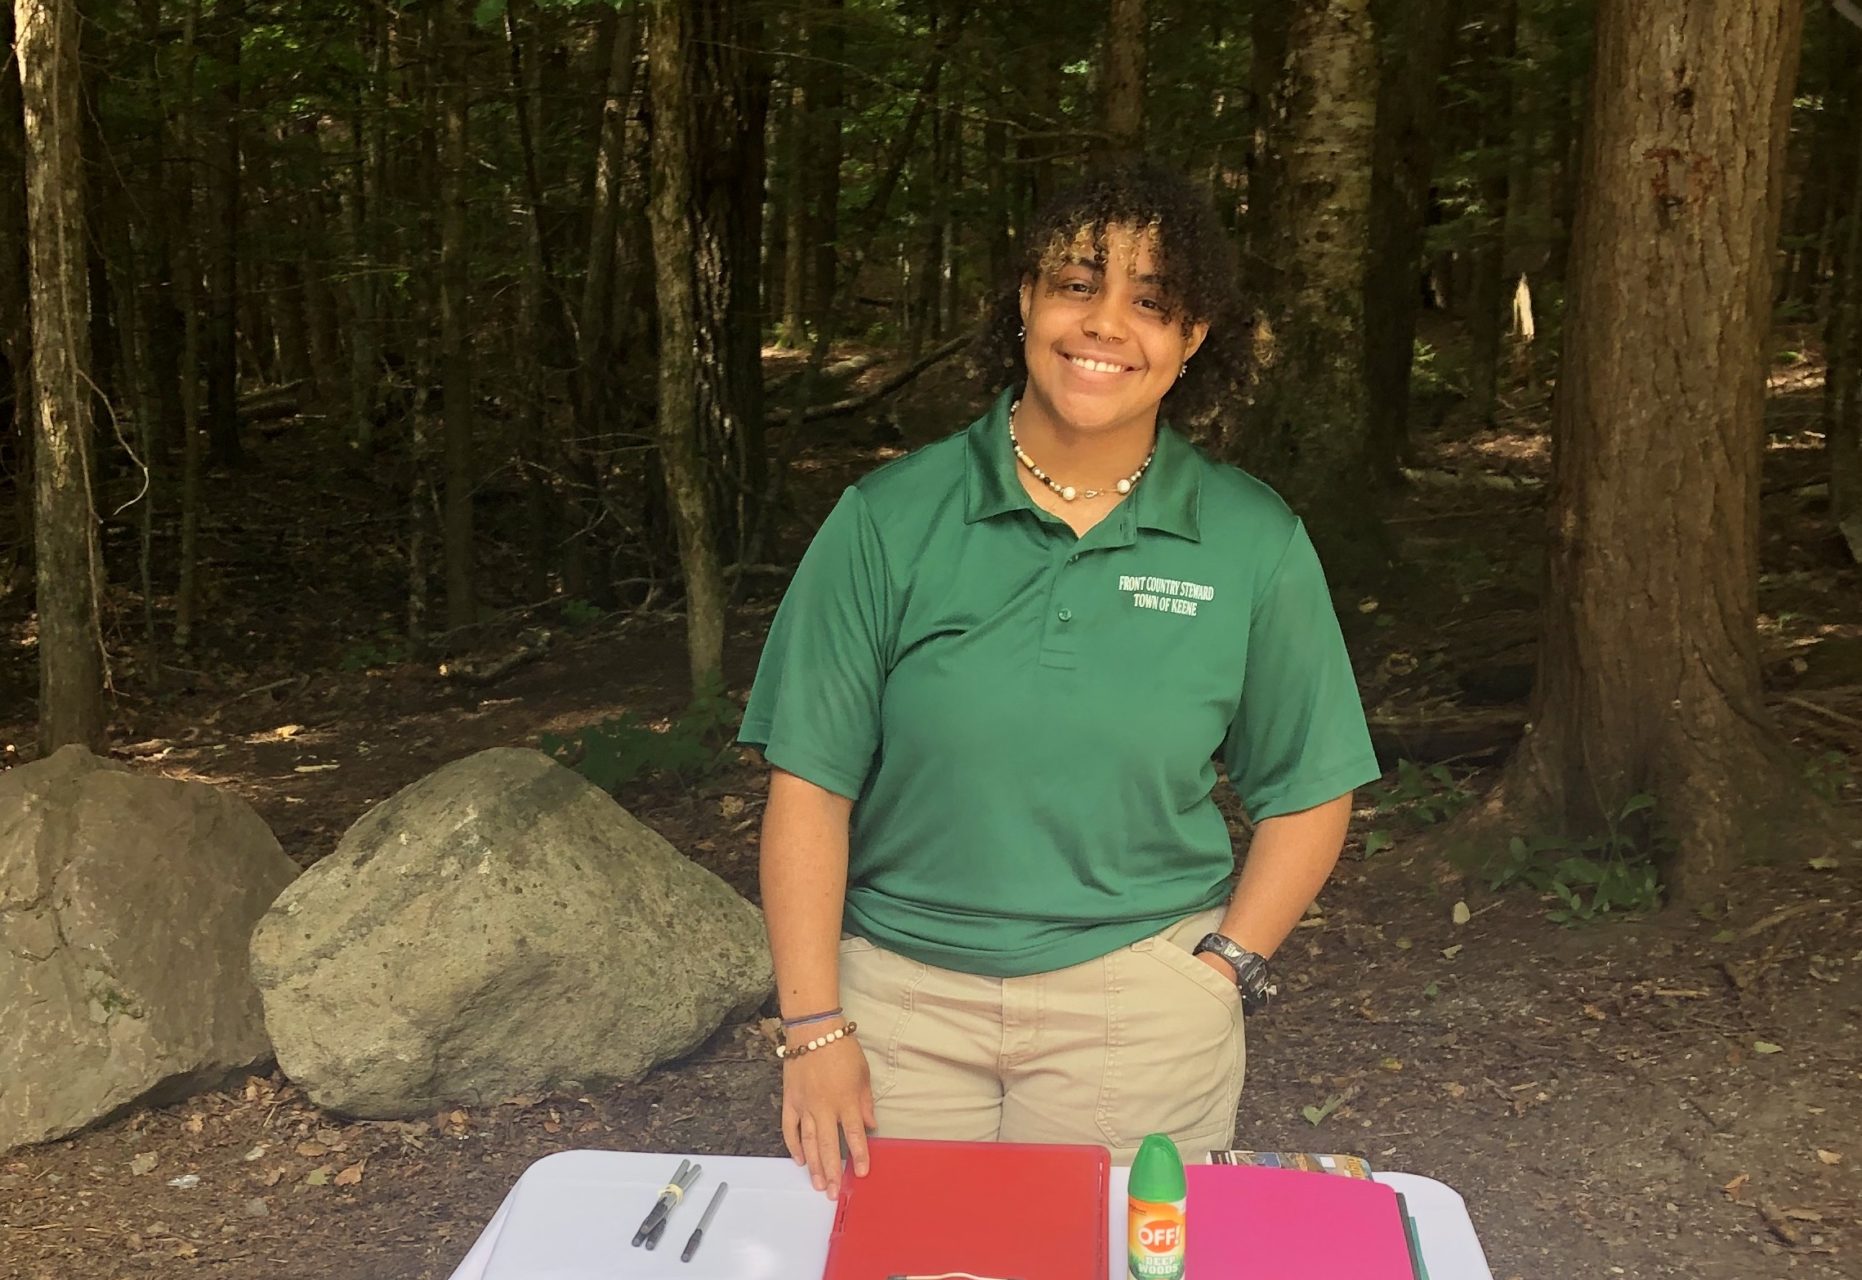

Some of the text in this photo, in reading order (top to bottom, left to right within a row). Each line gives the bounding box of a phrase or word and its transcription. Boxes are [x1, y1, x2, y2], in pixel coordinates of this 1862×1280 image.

[1118, 575, 1214, 601] FRONT COUNTRY STEWARD
[1133, 593, 1198, 616] TOWN OF KEENE
[1138, 1224, 1181, 1247] OFF!
[1138, 1263, 1179, 1275] WOODS
[1145, 1255, 1176, 1266] DEEP
